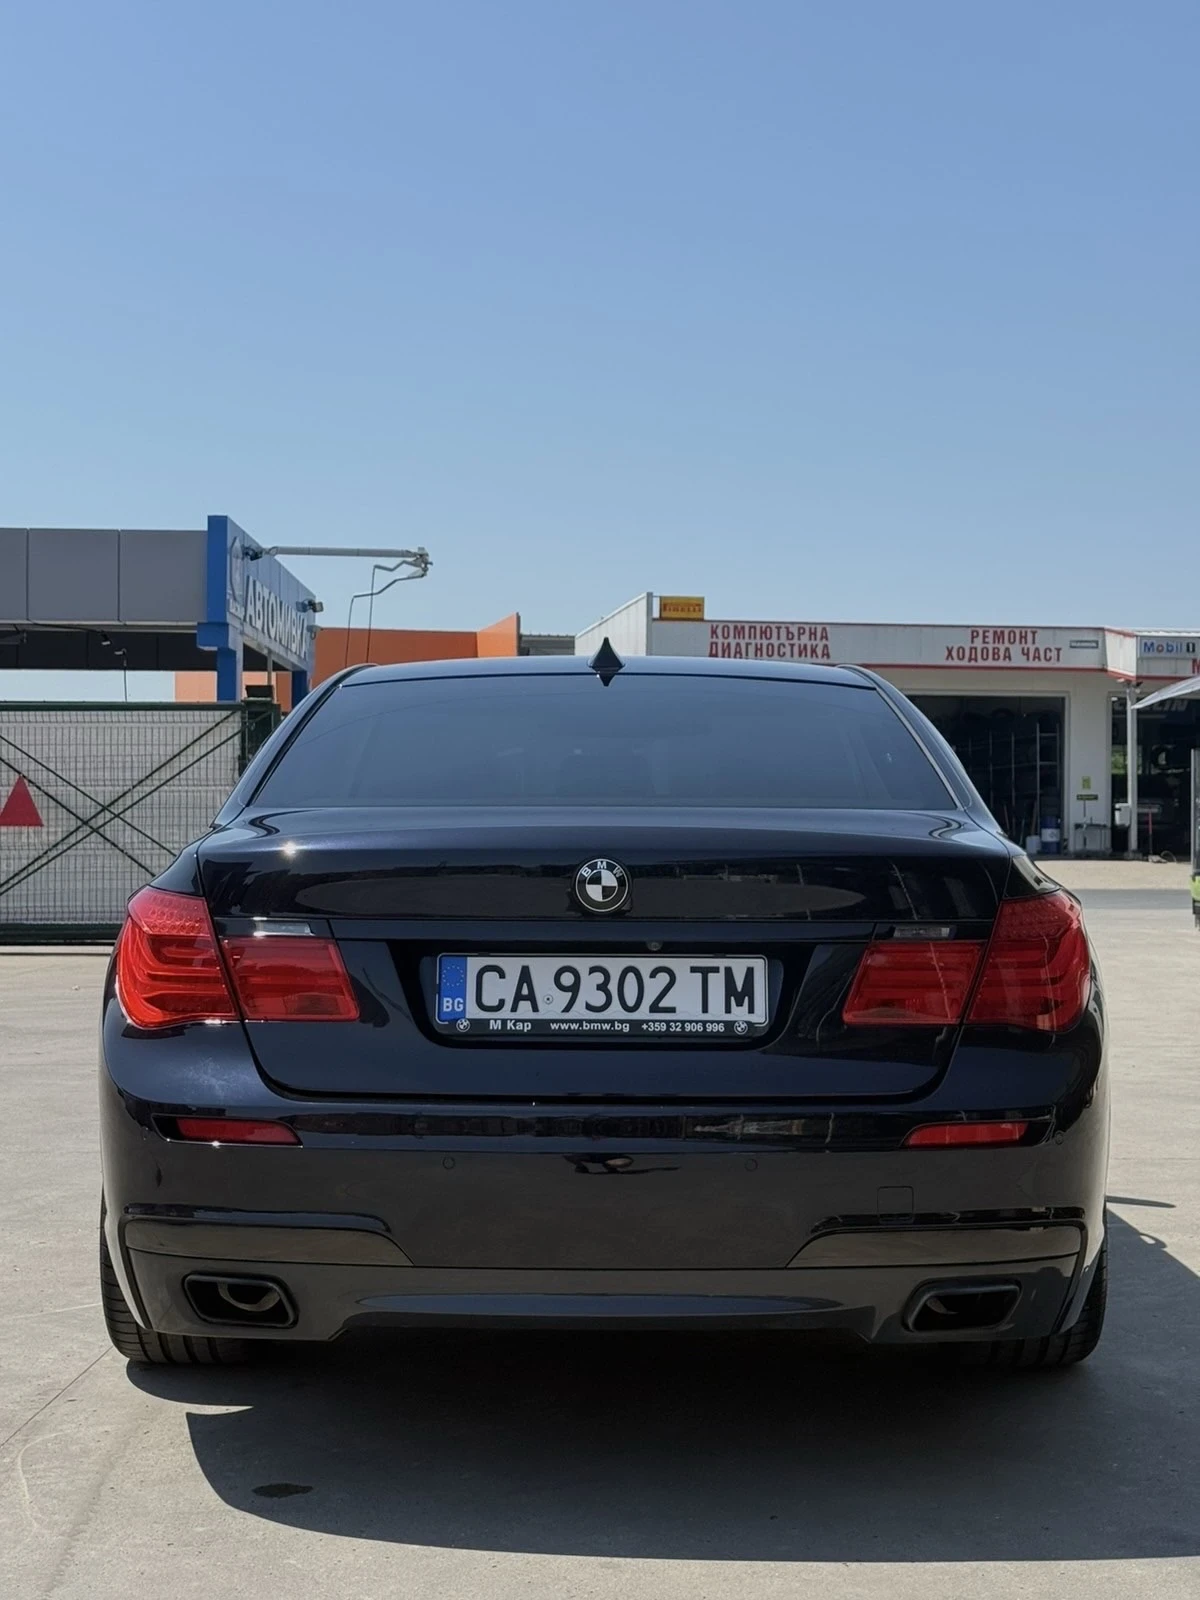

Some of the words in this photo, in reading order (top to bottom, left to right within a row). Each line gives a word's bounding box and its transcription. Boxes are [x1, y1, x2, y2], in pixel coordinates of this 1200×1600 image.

[710, 624, 829, 641] КОМПЮТЪРНА
[970, 629, 1038, 646] РЕМОНТ
[708, 641, 831, 660] ДИАГНОСТИКА
[945, 646, 1012, 663] ХОДОВА
[1021, 647, 1063, 662] ЧАСТ
[1143, 641, 1183, 654] Mobil
[581, 861, 623, 878] BMW
[475, 964, 540, 1013] CA
[553, 965, 677, 1014] 9302
[689, 966, 755, 1015] TM
[443, 997, 465, 1012] BG
[550, 1020, 630, 1032] www.bmw.bg
[641, 1022, 667, 1032] +359
[669, 1022, 682, 1032] 32
[684, 1022, 704, 1032] 906
[706, 1023, 725, 1033] 996
